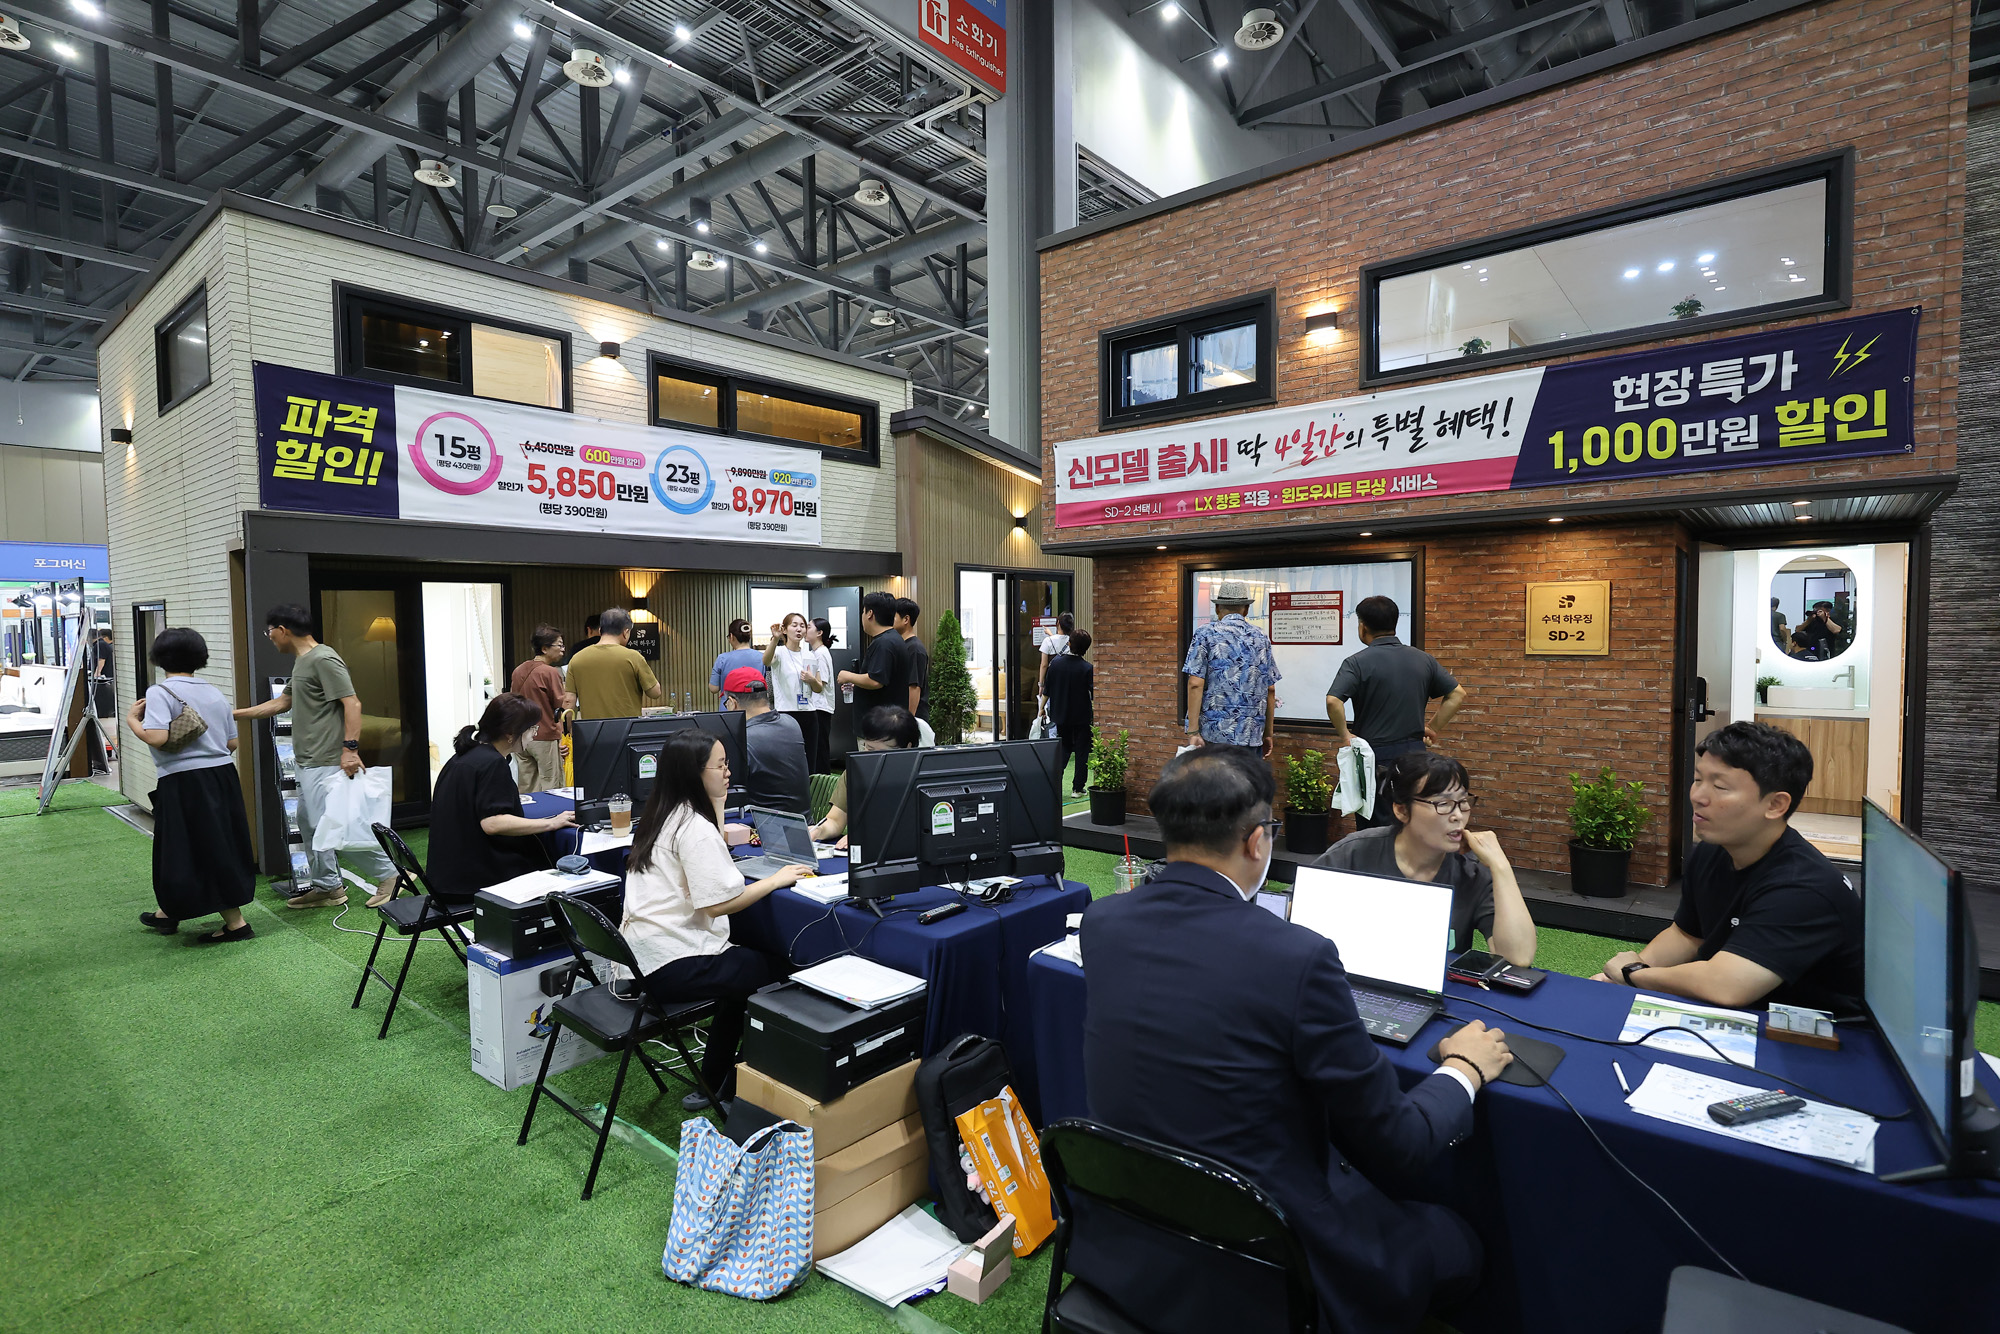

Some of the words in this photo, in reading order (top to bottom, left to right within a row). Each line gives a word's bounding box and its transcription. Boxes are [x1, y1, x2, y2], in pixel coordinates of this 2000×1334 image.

[956, 14, 998, 57] 소화기
[951, 35, 965, 51] Fire
[965, 45, 1004, 77] Extinguisher
[280, 396, 378, 444] 파격
[1548, 414, 1759, 474] 1,000만원
[1774, 389, 1887, 448] 할인
[434, 433, 481, 461] 15평
[524, 441, 574, 457] 6,450만원
[1068, 448, 1150, 490] 신모델
[1157, 438, 1228, 480] 출시!
[1237, 433, 1268, 467] 딱
[1275, 421, 1364, 466] 4일간의
[1371, 405, 1428, 453] 특별
[1433, 396, 1514, 440] 혜택!
[272, 438, 384, 486] 할인!!
[665, 463, 700, 486] 23평
[497, 481, 524, 492] 할인가
[527, 463, 649, 504] 5,850만원
[1195, 495, 1213, 511] LX
[1216, 492, 1241, 510] 창호
[1244, 489, 1270, 506] 적용
[1282, 481, 1352, 504] 윈도우시트
[1356, 478, 1387, 496] 무상
[1390, 473, 1438, 493] 서비스
[539, 503, 563, 515] (평당
[564, 505, 608, 519] 390만원)
[711, 501, 730, 511] 할인가
[732, 486, 817, 518] 8,970만원
[1104, 505, 1131, 518] SD-2
[1133, 503, 1150, 516] 선택
[1152, 502, 1162, 514] 시
[747, 522, 761, 531] (평당
[762, 522, 788, 532] 390만원)
[33, 558, 87, 570] 포그머신
[1541, 613, 1561, 624] 수덕
[1562, 613, 1593, 624] 하우징
[1548, 630, 1586, 641] SD-2
